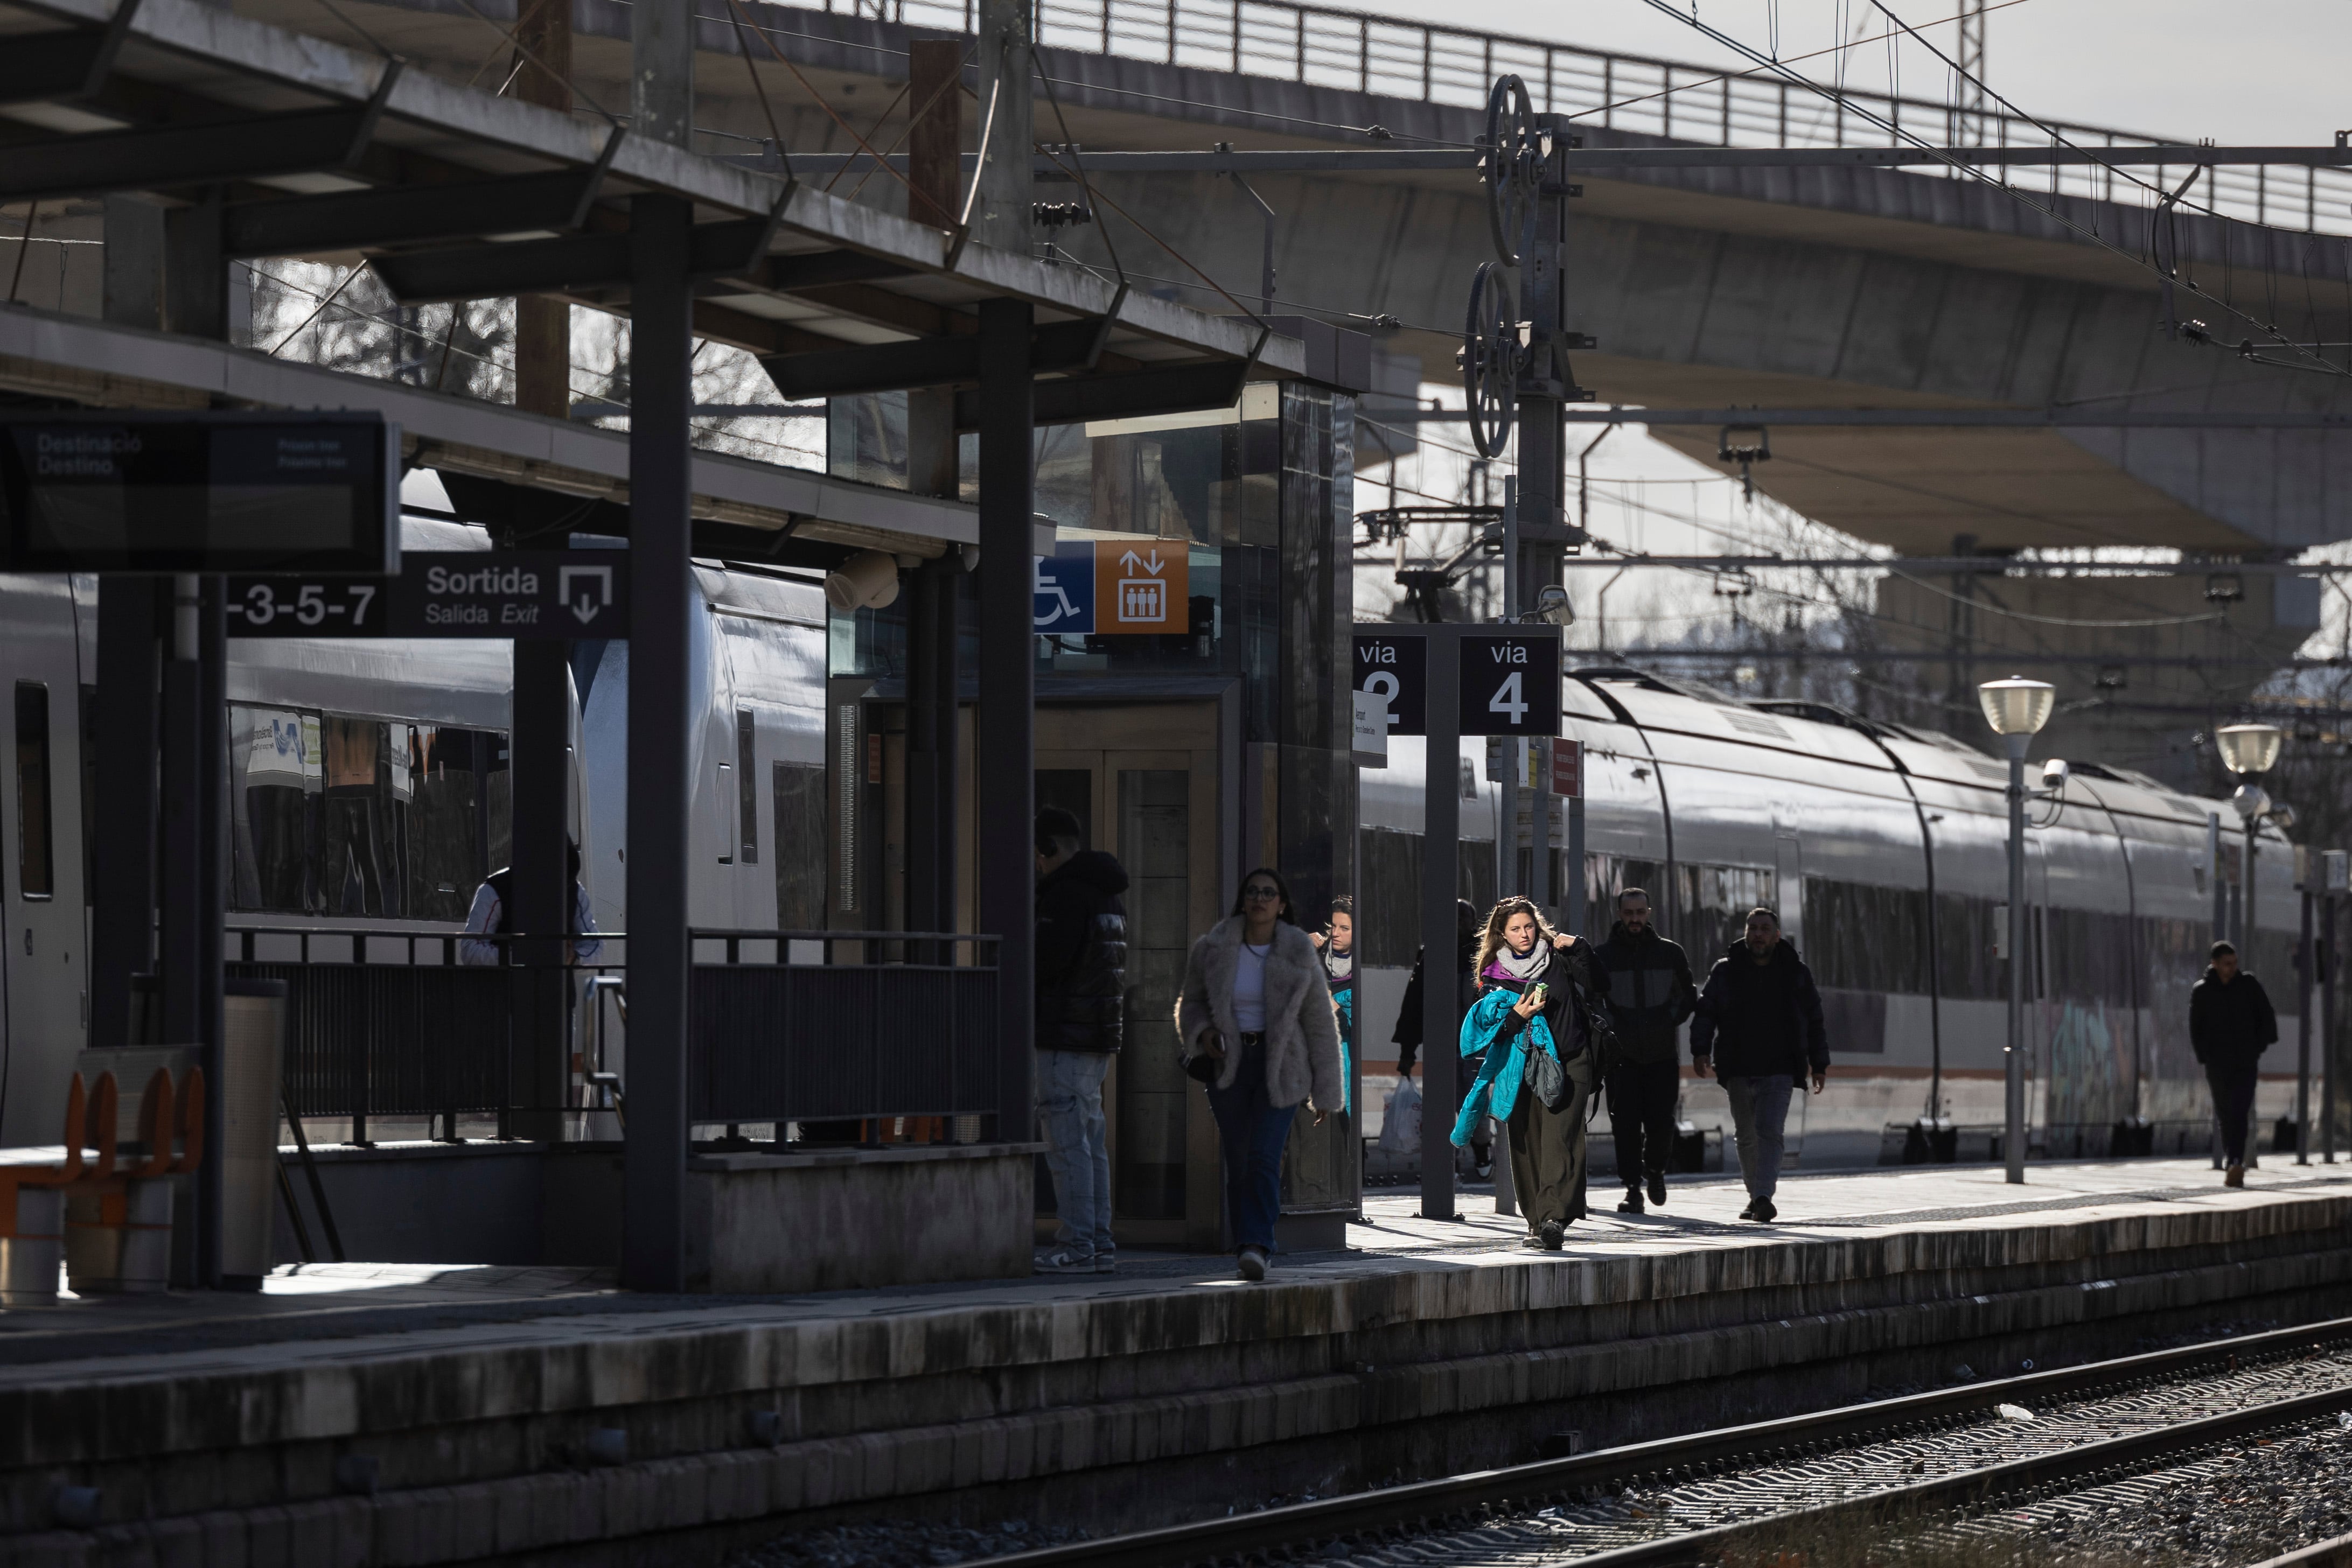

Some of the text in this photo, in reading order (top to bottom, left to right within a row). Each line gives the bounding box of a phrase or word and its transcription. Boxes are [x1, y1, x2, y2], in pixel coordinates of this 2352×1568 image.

[38, 433, 142, 453] Destinació
[38, 455, 113, 475] Destino
[427, 566, 539, 594] Sortida
[425, 603, 539, 624] Salida Exit
[1360, 641, 1396, 663] via
[1491, 641, 1527, 663] via
[1363, 671, 1400, 724] 2
[1489, 672, 1528, 724] 4
